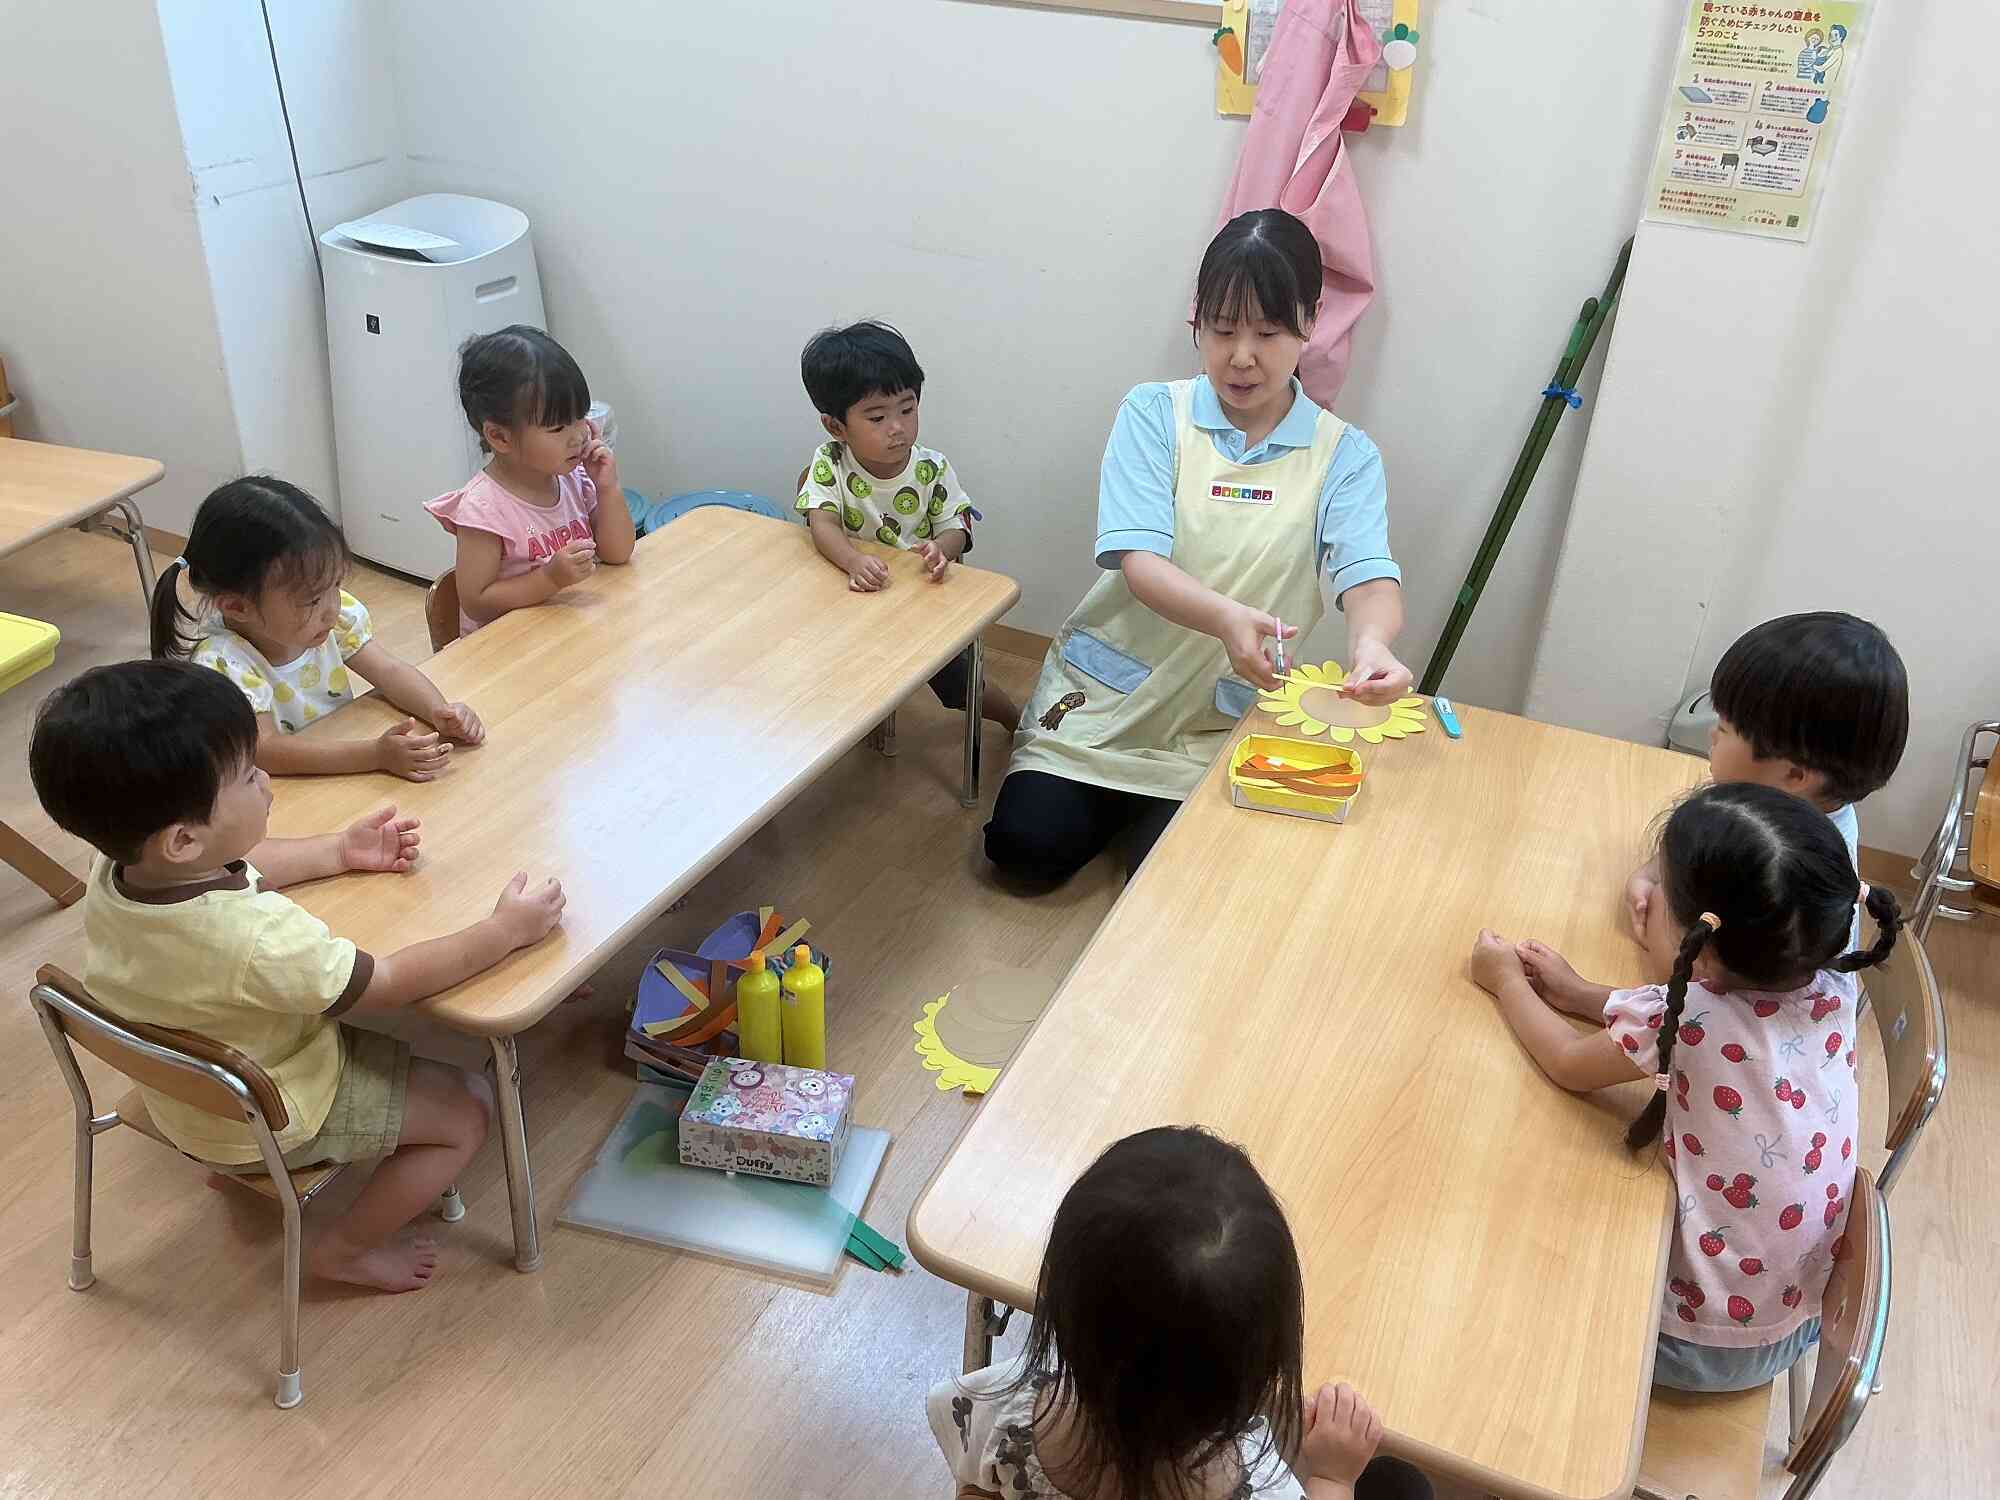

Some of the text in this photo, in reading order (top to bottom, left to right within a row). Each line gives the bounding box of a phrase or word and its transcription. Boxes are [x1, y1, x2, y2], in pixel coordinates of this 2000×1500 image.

[1700, 16, 1802, 34] 防ぐためにチェックしたい
[1697, 27, 1739, 40] 5つのこと
[1692, 73, 1700, 83] 1
[1764, 81, 1772, 91] 2
[1684, 112, 1692, 121] 3
[1755, 120, 1763, 130] 4
[1675, 150, 1683, 159] 5
[527, 519, 592, 561] ANPA
[736, 1155, 774, 1170] Duffy
